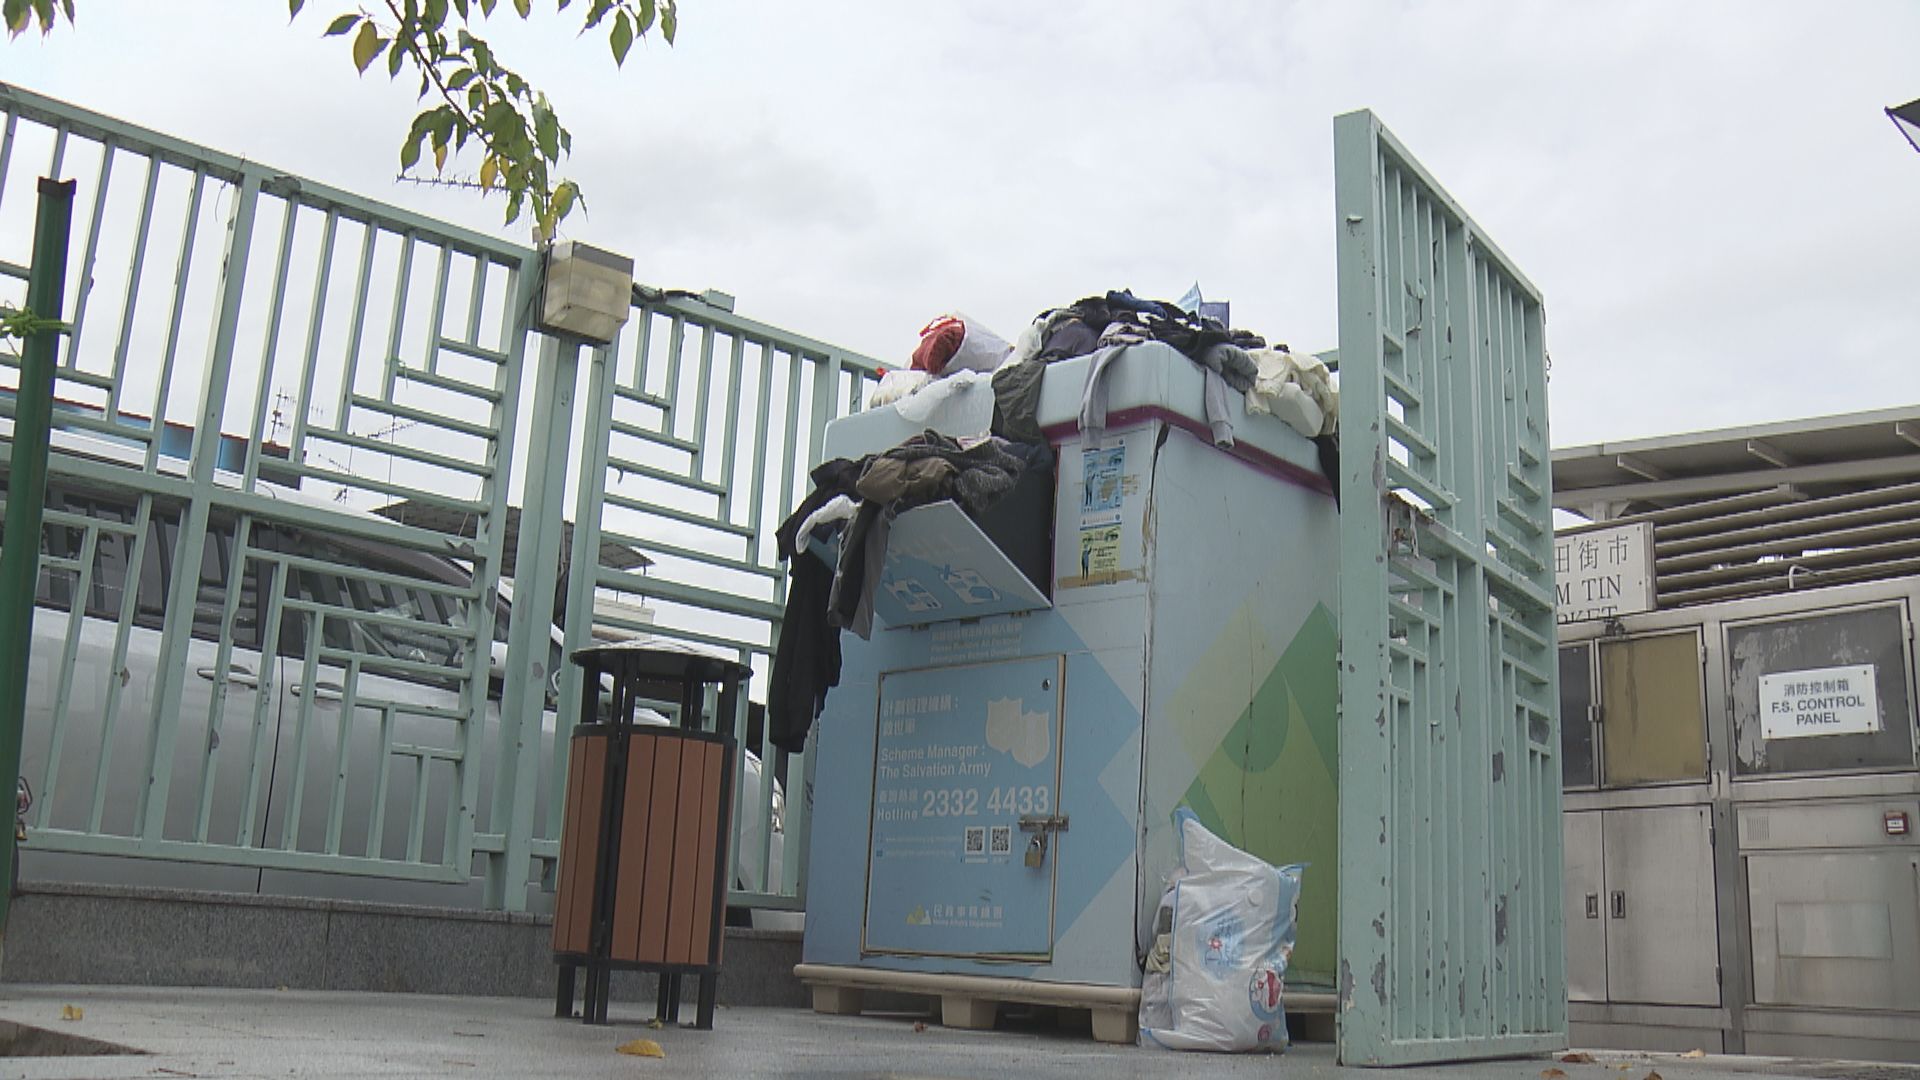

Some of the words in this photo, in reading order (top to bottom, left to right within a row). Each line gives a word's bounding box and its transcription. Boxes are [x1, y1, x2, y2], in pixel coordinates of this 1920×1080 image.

[1582, 574, 1621, 601] TIN
[1784, 678, 1849, 697] 消防控制箱
[1772, 701, 1794, 713] F.S.
[1797, 694, 1865, 711] CONTROL
[1796, 712, 1840, 725] PANEL
[881, 747, 924, 761] Scheme
[927, 743, 978, 761] Manager
[880, 765, 899, 779] The
[902, 763, 955, 778] Salvation
[958, 761, 991, 778] Army
[922, 788, 979, 817] 2332
[986, 785, 1049, 816] 4433
[876, 808, 918, 822] Hotline
